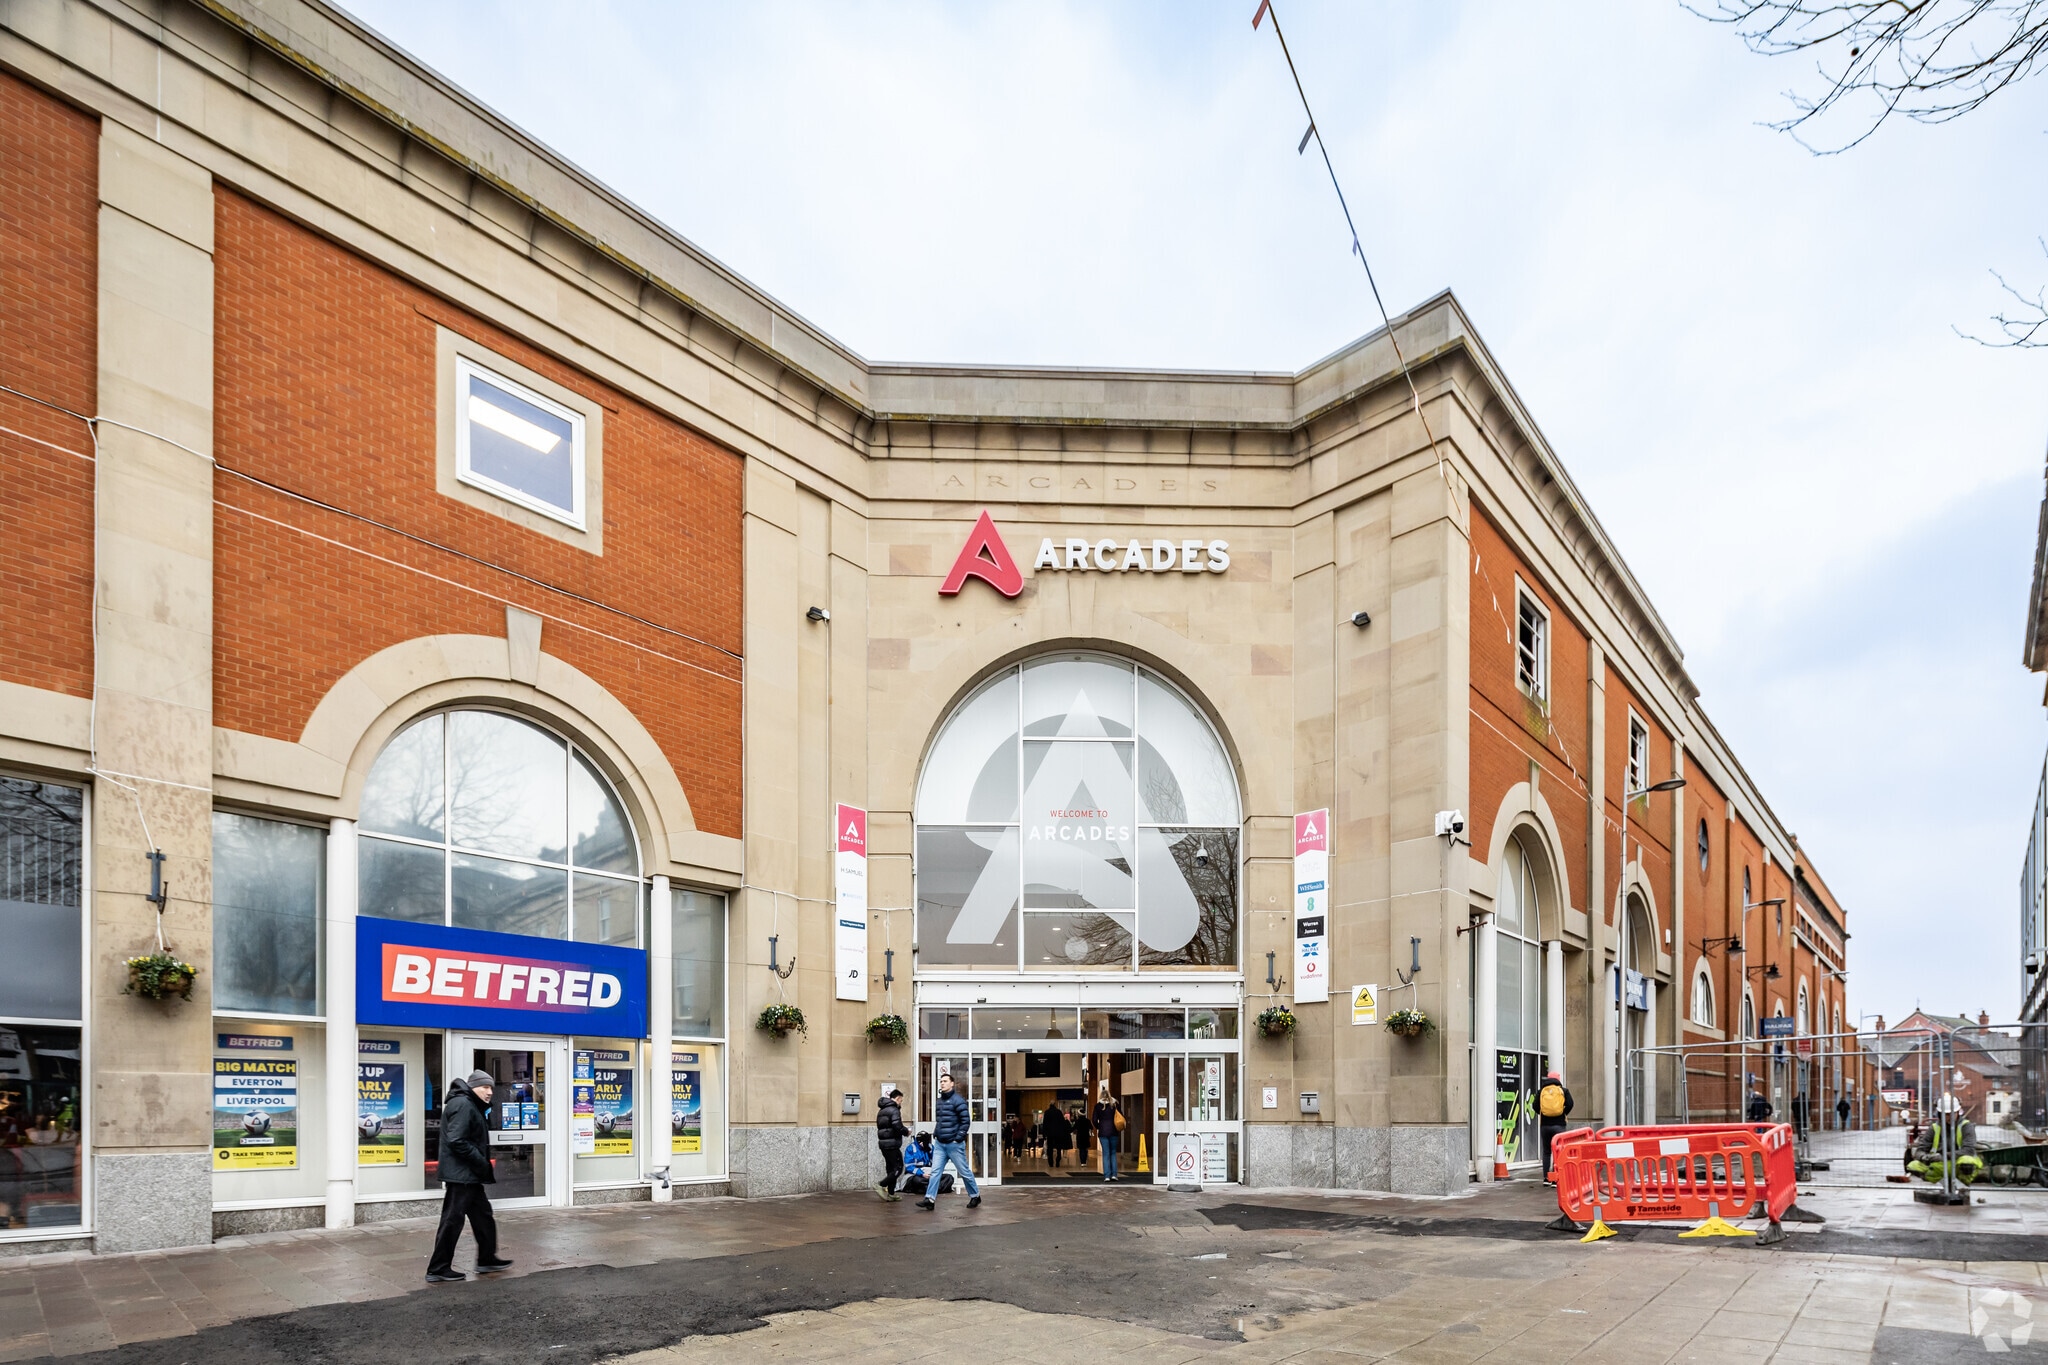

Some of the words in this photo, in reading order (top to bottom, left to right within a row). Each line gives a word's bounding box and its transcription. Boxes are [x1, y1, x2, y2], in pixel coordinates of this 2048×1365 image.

[945, 474, 1217, 492] ARCADES
[1034, 538, 1230, 574] ARCADES
[1029, 826, 1130, 840] ARCADES
[840, 836, 864, 845] ARCADES
[1298, 834, 1324, 844] ARCADES
[1300, 882, 1323, 892] WHSmith
[848, 970, 858, 978] JD
[392, 954, 622, 1008] BETFRED
[229, 1038, 283, 1047] BETFRED
[216, 1062, 240, 1072] BIG
[244, 1063, 296, 1073] MATCH
[366, 1067, 385, 1077] UP
[595, 1072, 602, 1080] 2
[603, 1072, 617, 1081] UP
[675, 1073, 687, 1081] UP
[358, 1081, 392, 1091] ARLY
[594, 1084, 622, 1093] ARLY
